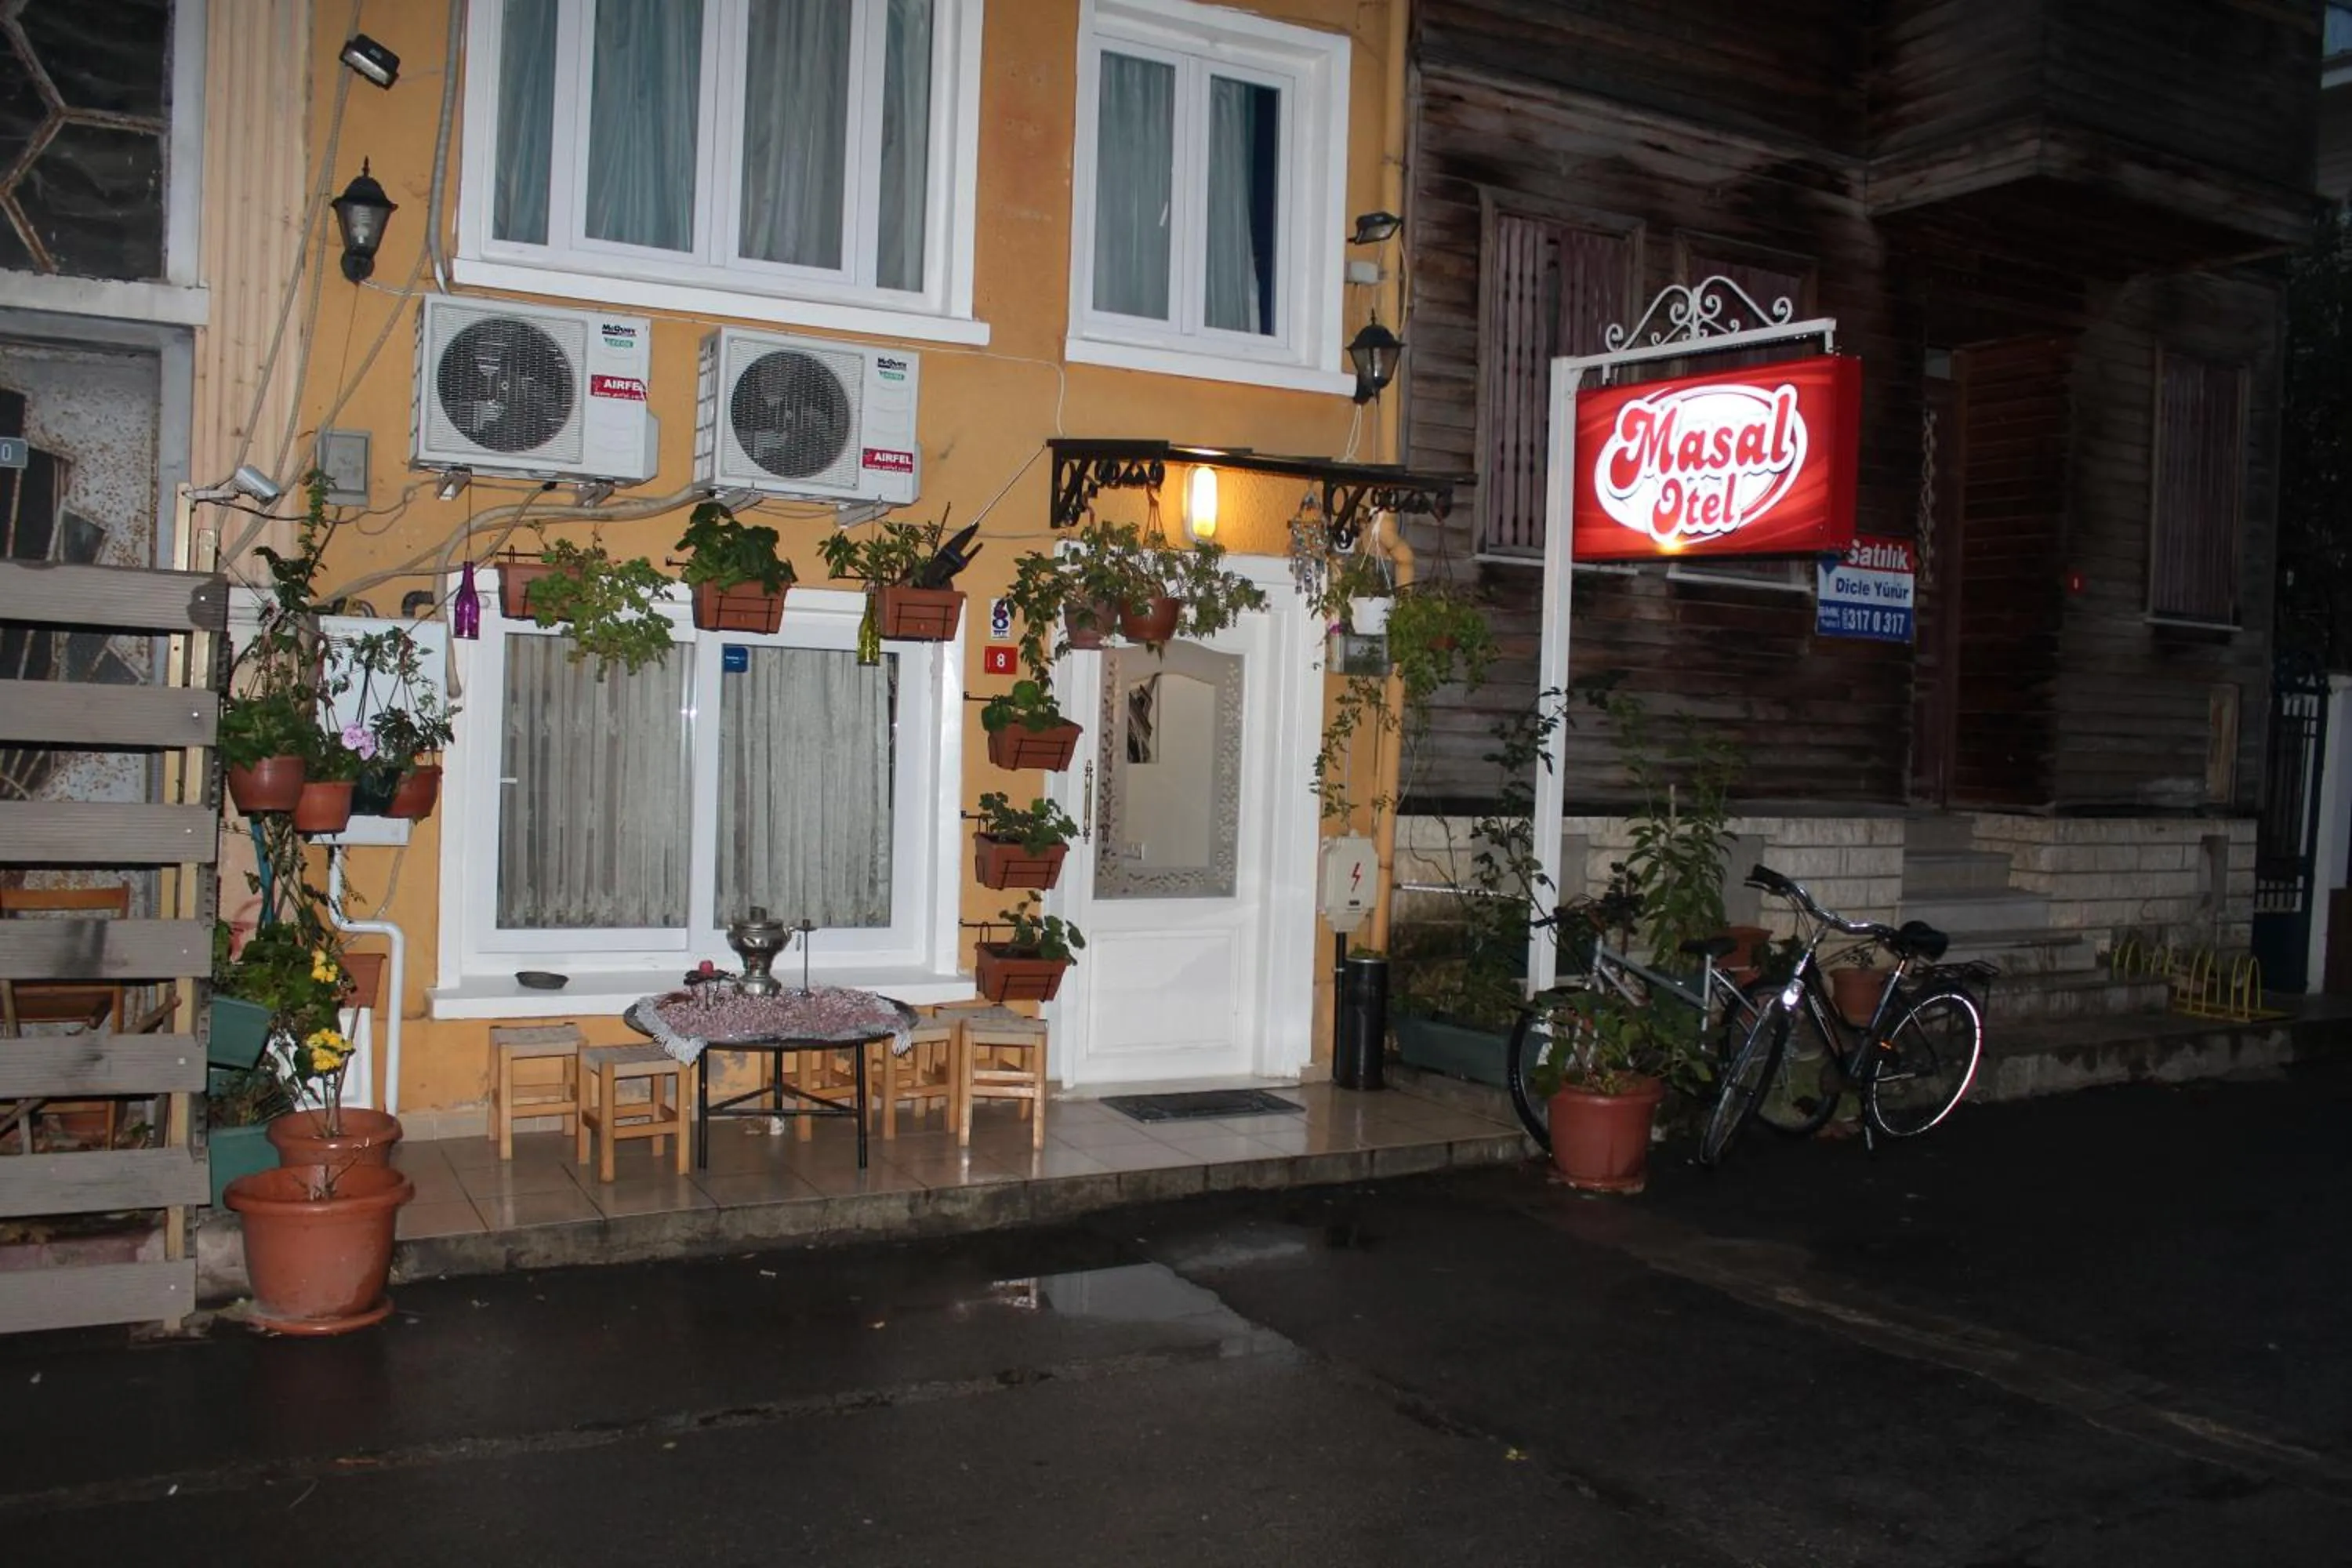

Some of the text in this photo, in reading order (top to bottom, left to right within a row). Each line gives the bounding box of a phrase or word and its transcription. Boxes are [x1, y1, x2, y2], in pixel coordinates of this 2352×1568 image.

[1610, 393, 1791, 490] Masal
[874, 452, 912, 465] AIRFEL
[1652, 473, 1737, 535] Otel
[1836, 577, 1870, 596] Dicle
[1848, 609, 1870, 631] 317
[1882, 612, 1905, 634] 317
[996, 652, 1005, 667] 8
